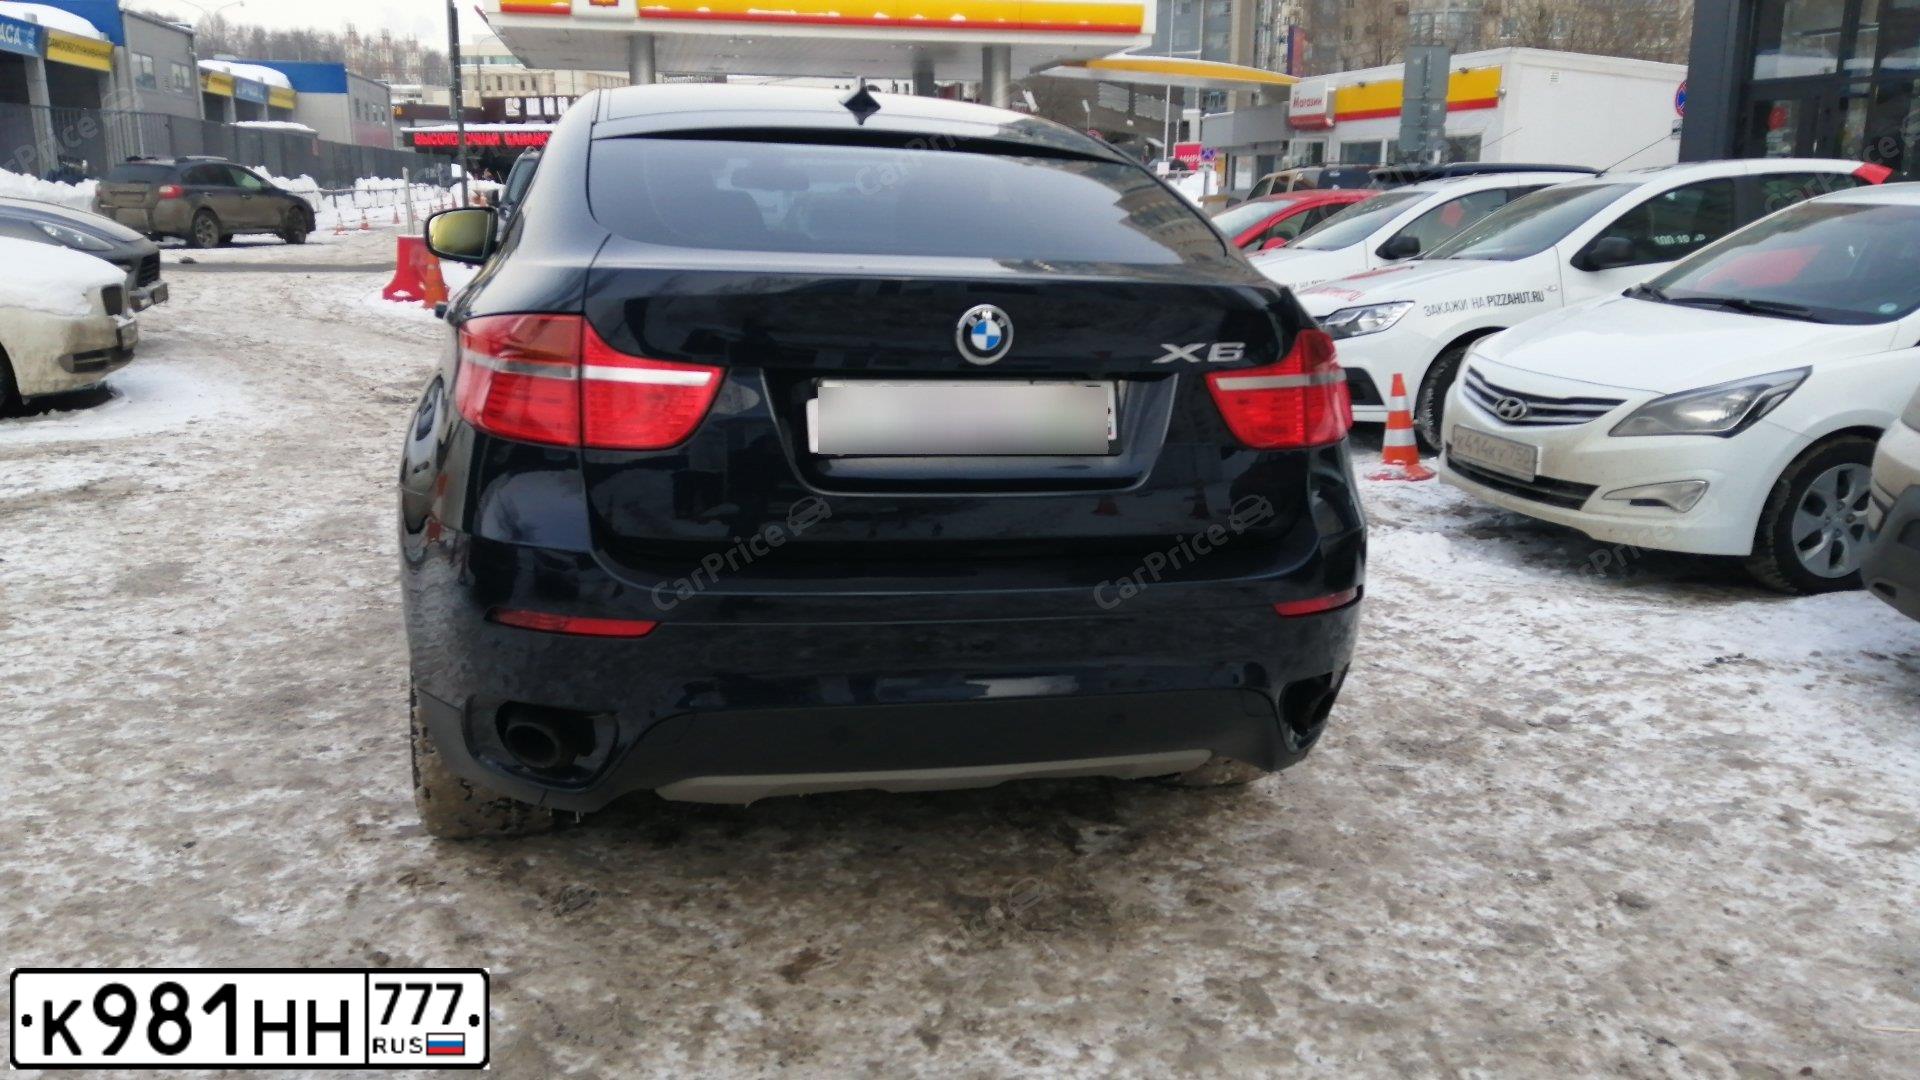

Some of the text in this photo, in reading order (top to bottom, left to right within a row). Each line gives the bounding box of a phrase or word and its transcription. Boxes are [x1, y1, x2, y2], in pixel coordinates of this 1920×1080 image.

[1293, 96, 1323, 109] Магазин
[1423, 290, 1545, 317] ЗАКАЖИ НА PIZZAHUT.RU
[1152, 342, 1246, 364] X6
